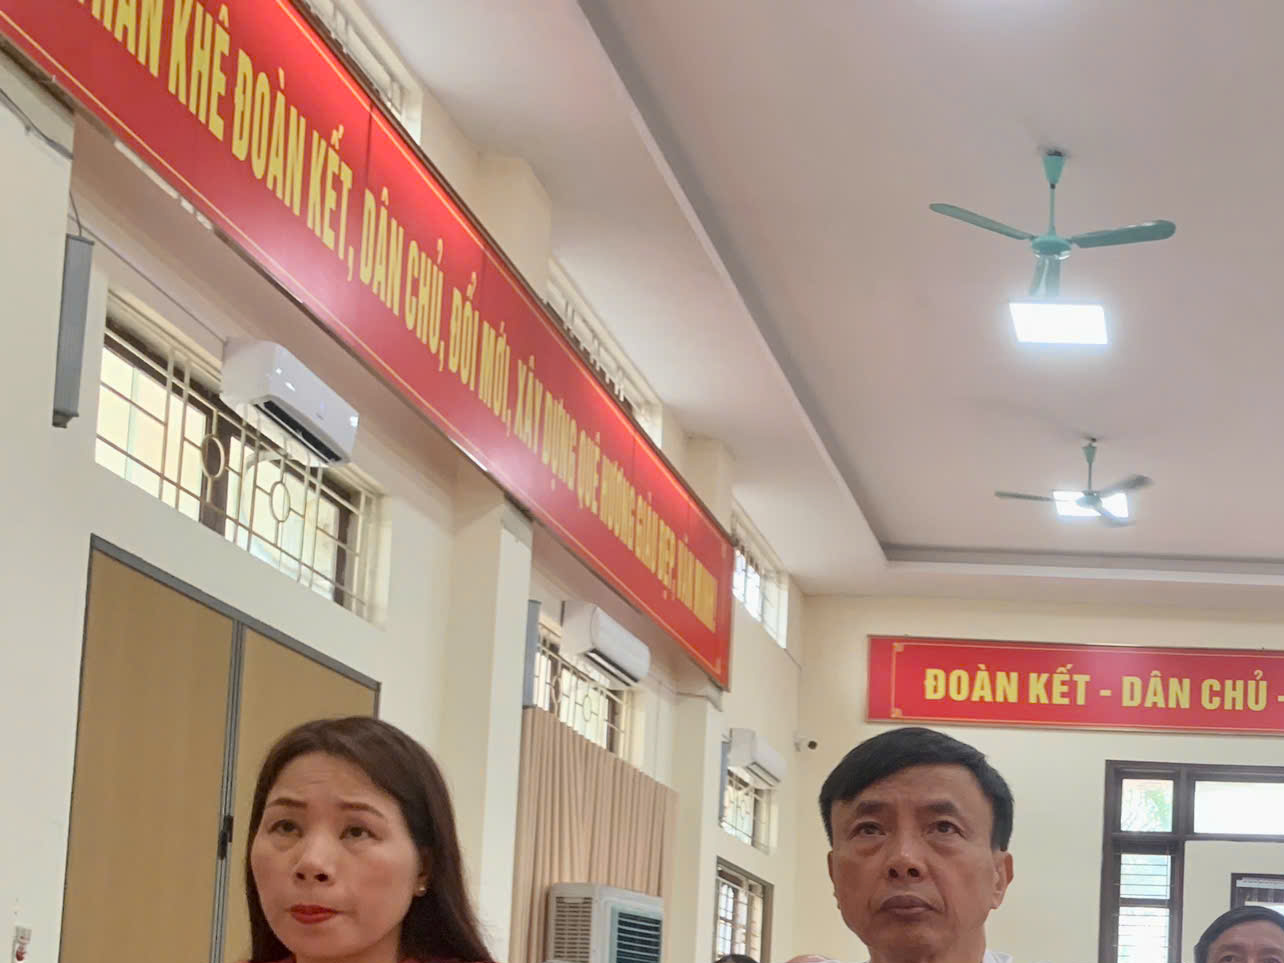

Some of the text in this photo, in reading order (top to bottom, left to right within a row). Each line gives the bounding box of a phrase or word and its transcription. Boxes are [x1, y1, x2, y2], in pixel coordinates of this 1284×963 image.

[232, 48, 306, 217] ĐOÀN
[360, 186, 404, 316] DÂN
[449, 272, 479, 391] ĐỔI
[514, 355, 543, 455] XÂY
[924, 663, 1018, 703] ĐOÀN
[1029, 663, 1090, 705] KẾT
[1122, 670, 1190, 708] DÂN
[1201, 669, 1267, 711] CHỦ
